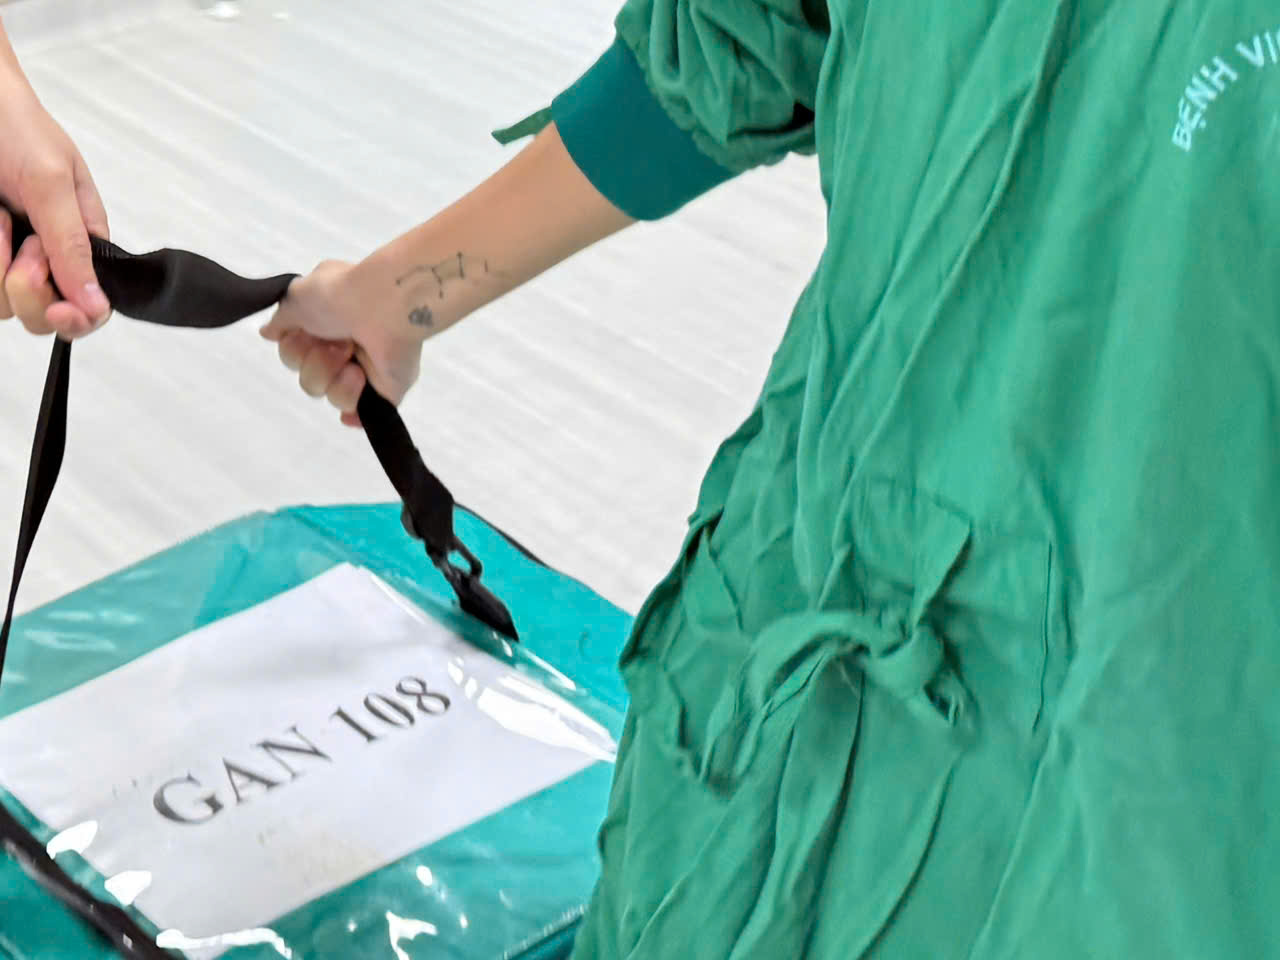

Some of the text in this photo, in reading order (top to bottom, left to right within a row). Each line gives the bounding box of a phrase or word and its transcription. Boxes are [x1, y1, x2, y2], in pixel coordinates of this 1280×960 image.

[1235, 25, 1280, 68] VI
[152, 676, 451, 826] GAN 108
